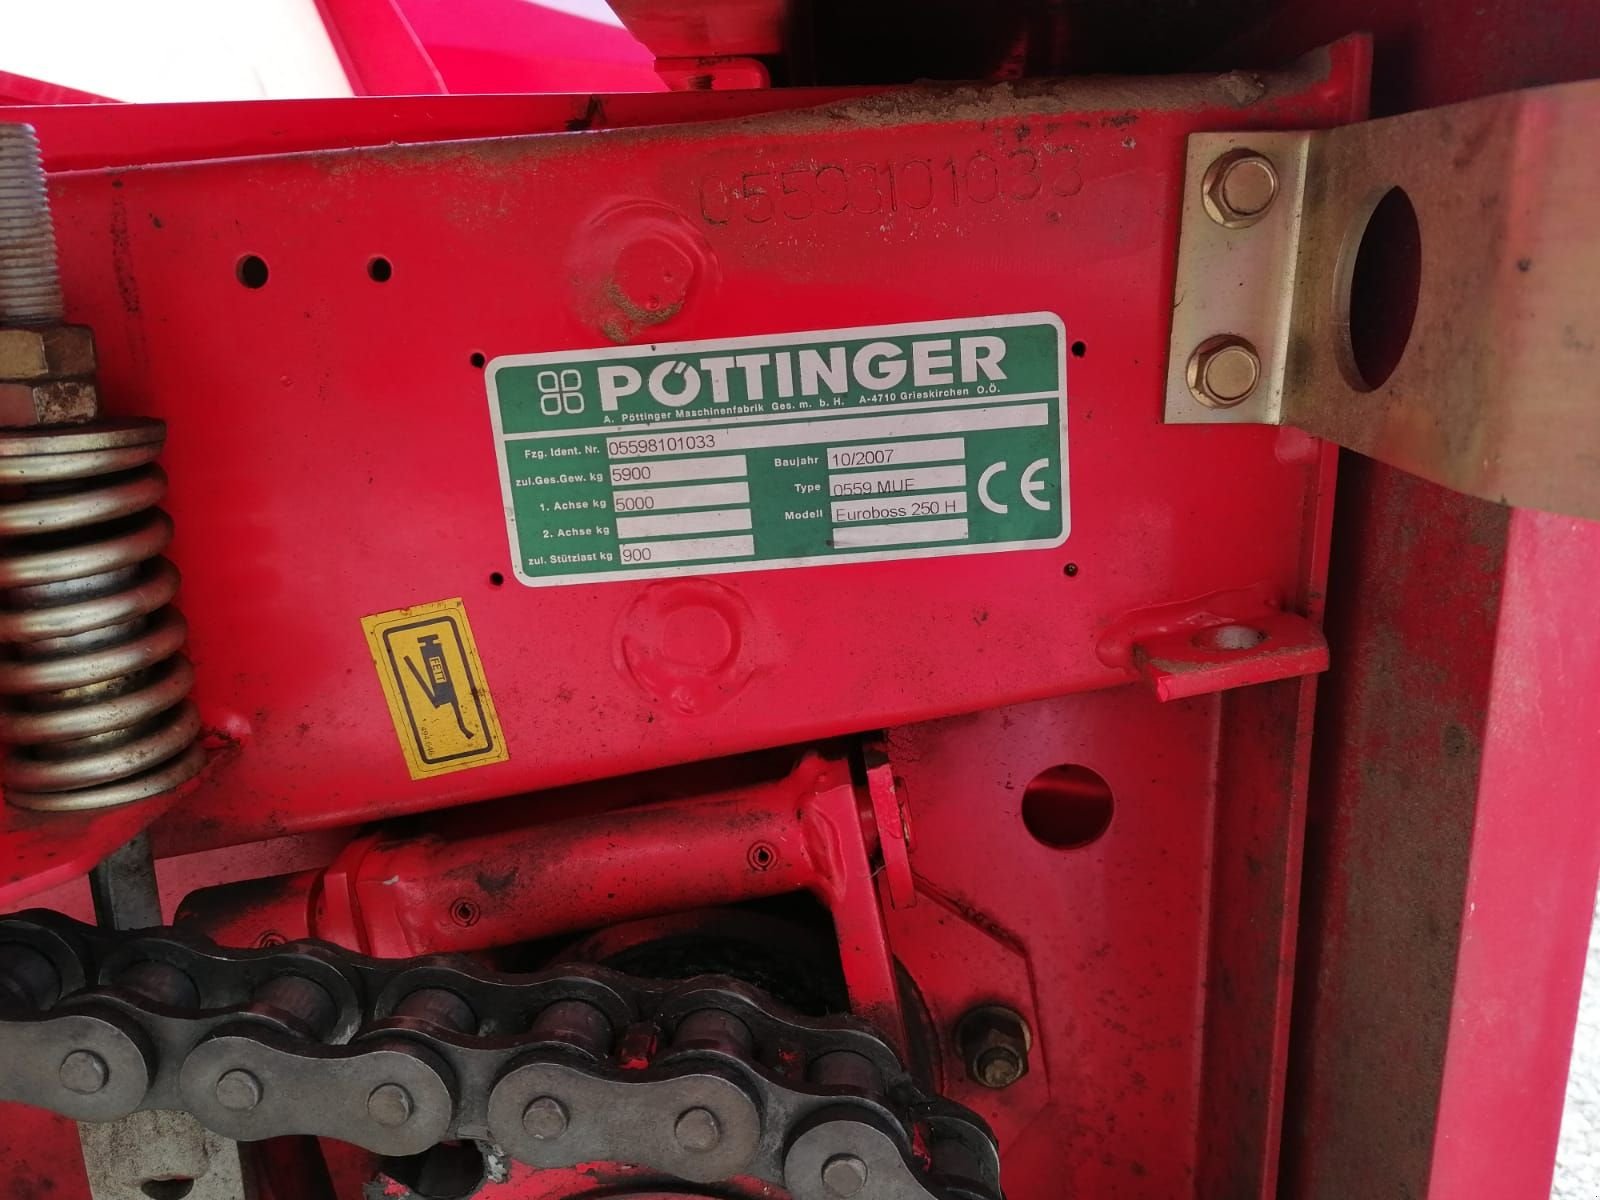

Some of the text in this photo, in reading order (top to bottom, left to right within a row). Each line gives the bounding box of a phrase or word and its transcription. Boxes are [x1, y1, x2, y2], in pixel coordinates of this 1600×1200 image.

[597, 335, 1008, 412] PÖTTINGER
[603, 382, 1001, 424] A. Pöttinger Maschinenfabrik Ges. m. b. H. A-4710 Grieskirchen O.Ö.
[524, 434, 716, 460] Fzg. Ident. Nr. 05598101033
[774, 449, 895, 467] Baujahr 10/2007
[590, 472, 603, 483] kg
[611, 466, 651, 482] 5900
[794, 482, 821, 494] Type
[833, 481, 872, 496] 0559
[977, 457, 1051, 514] CE
[539, 496, 654, 512] 1. Achse kg 5000
[784, 501, 956, 521] Modell Euroboss 250 H
[543, 526, 610, 539] 2. Achse kg
[528, 547, 651, 566] zul. Stützlast kg 900
[430, 657, 446, 682] FETT
